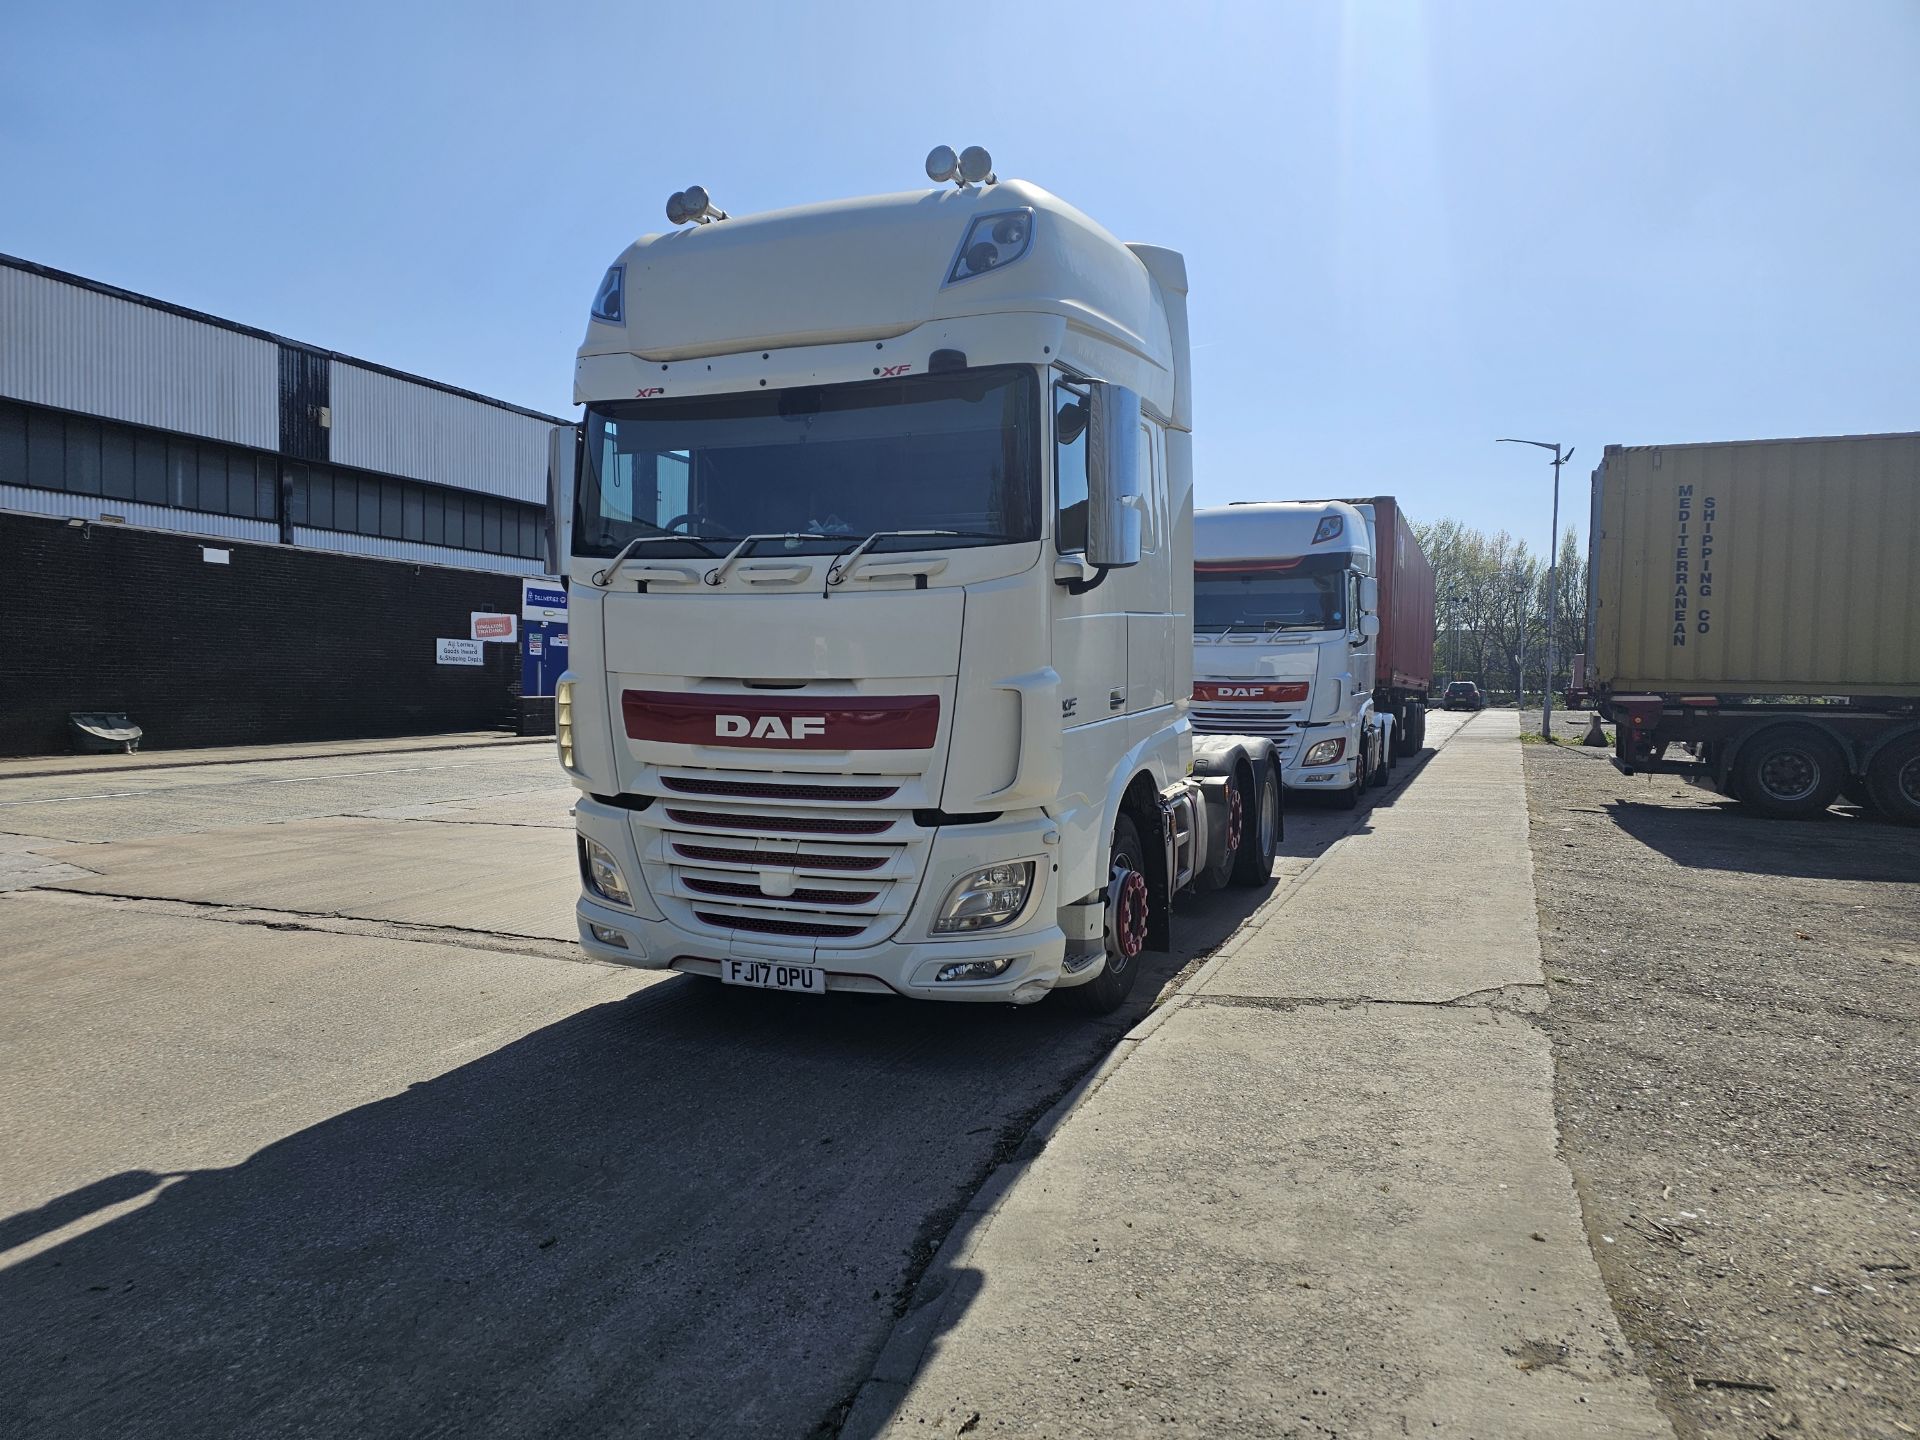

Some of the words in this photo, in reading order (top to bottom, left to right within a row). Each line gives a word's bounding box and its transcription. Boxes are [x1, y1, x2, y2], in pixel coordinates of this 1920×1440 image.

[880, 364, 912, 377] XF
[635, 387, 660, 398] XF
[1699, 497, 1716, 597] SHIPPING
[1673, 484, 1693, 646] MEDITERRANEAN
[1697, 609, 1710, 634] CO
[1217, 687, 1265, 697] DAF
[715, 714, 826, 740] DAF
[731, 962, 771, 984] FJ17
[776, 967, 813, 989] OPU
